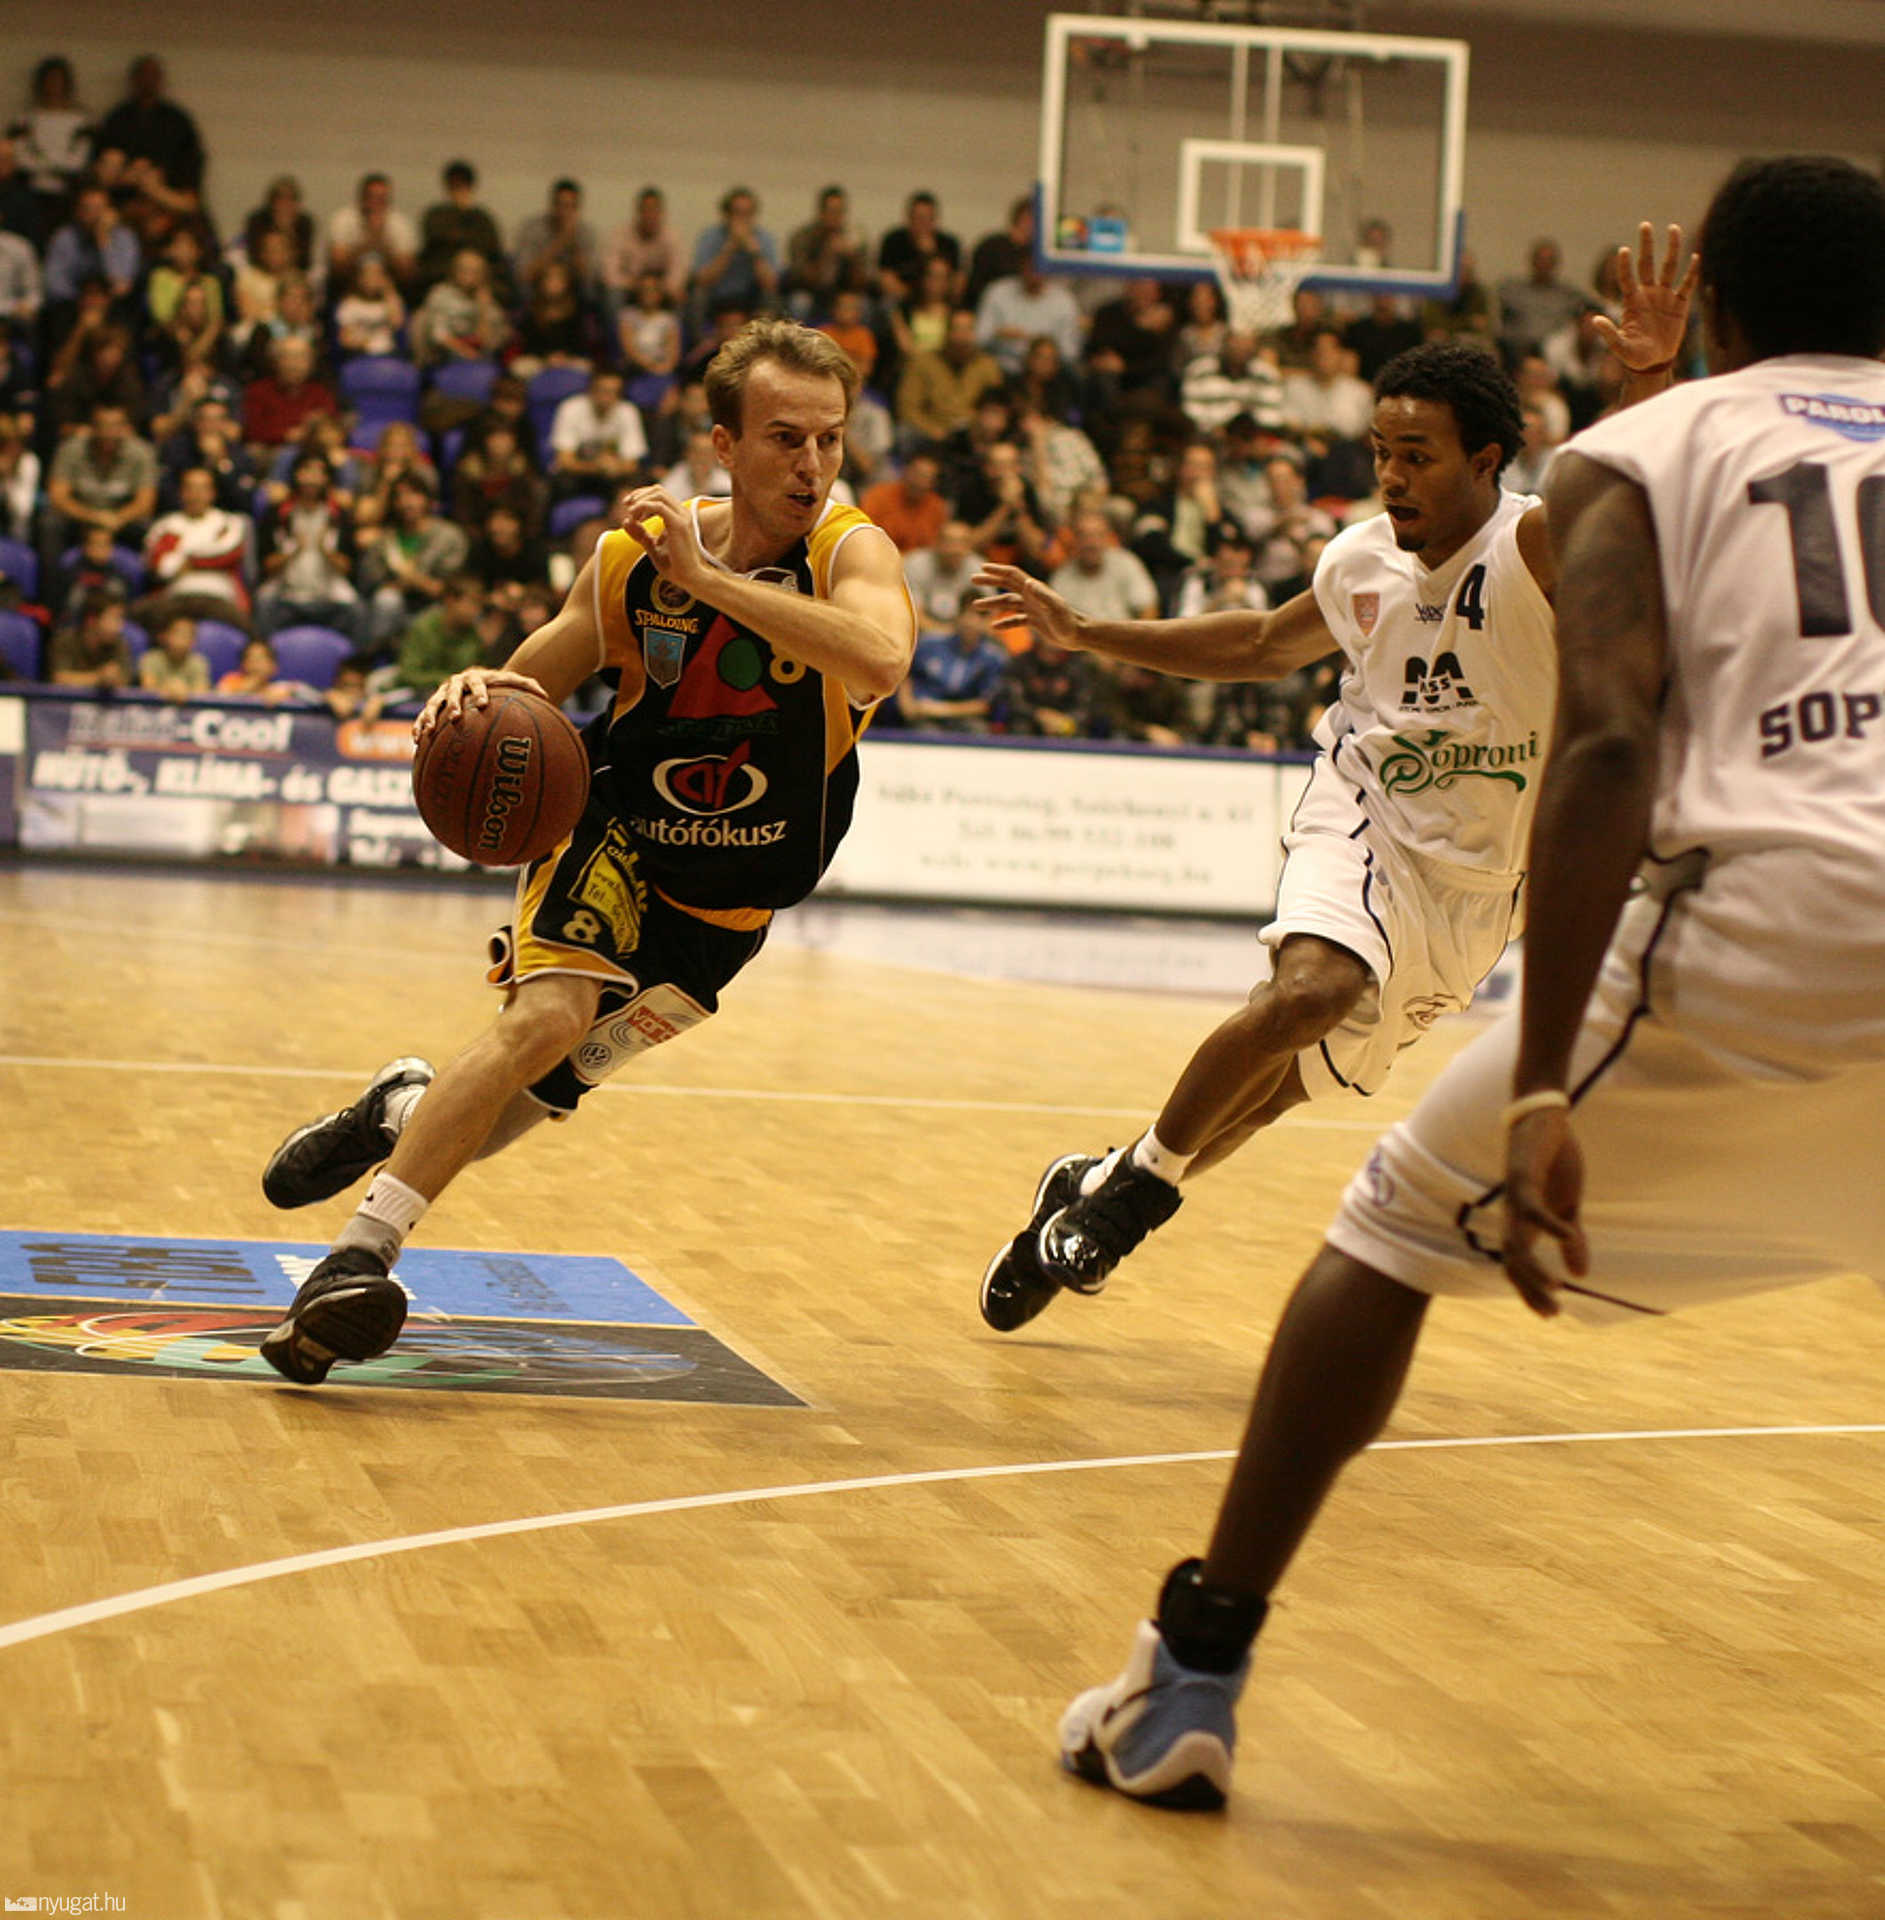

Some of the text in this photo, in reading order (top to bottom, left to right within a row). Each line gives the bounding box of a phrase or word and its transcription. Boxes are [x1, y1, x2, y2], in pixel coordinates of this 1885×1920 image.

[633, 608, 700, 634] SPALDING
[1455, 563, 1487, 631] 4
[1759, 690, 1881, 759] SOP
[479, 735, 532, 850] Wilson
[1379, 729, 1539, 799] Soproni
[562, 909, 602, 944] 8
